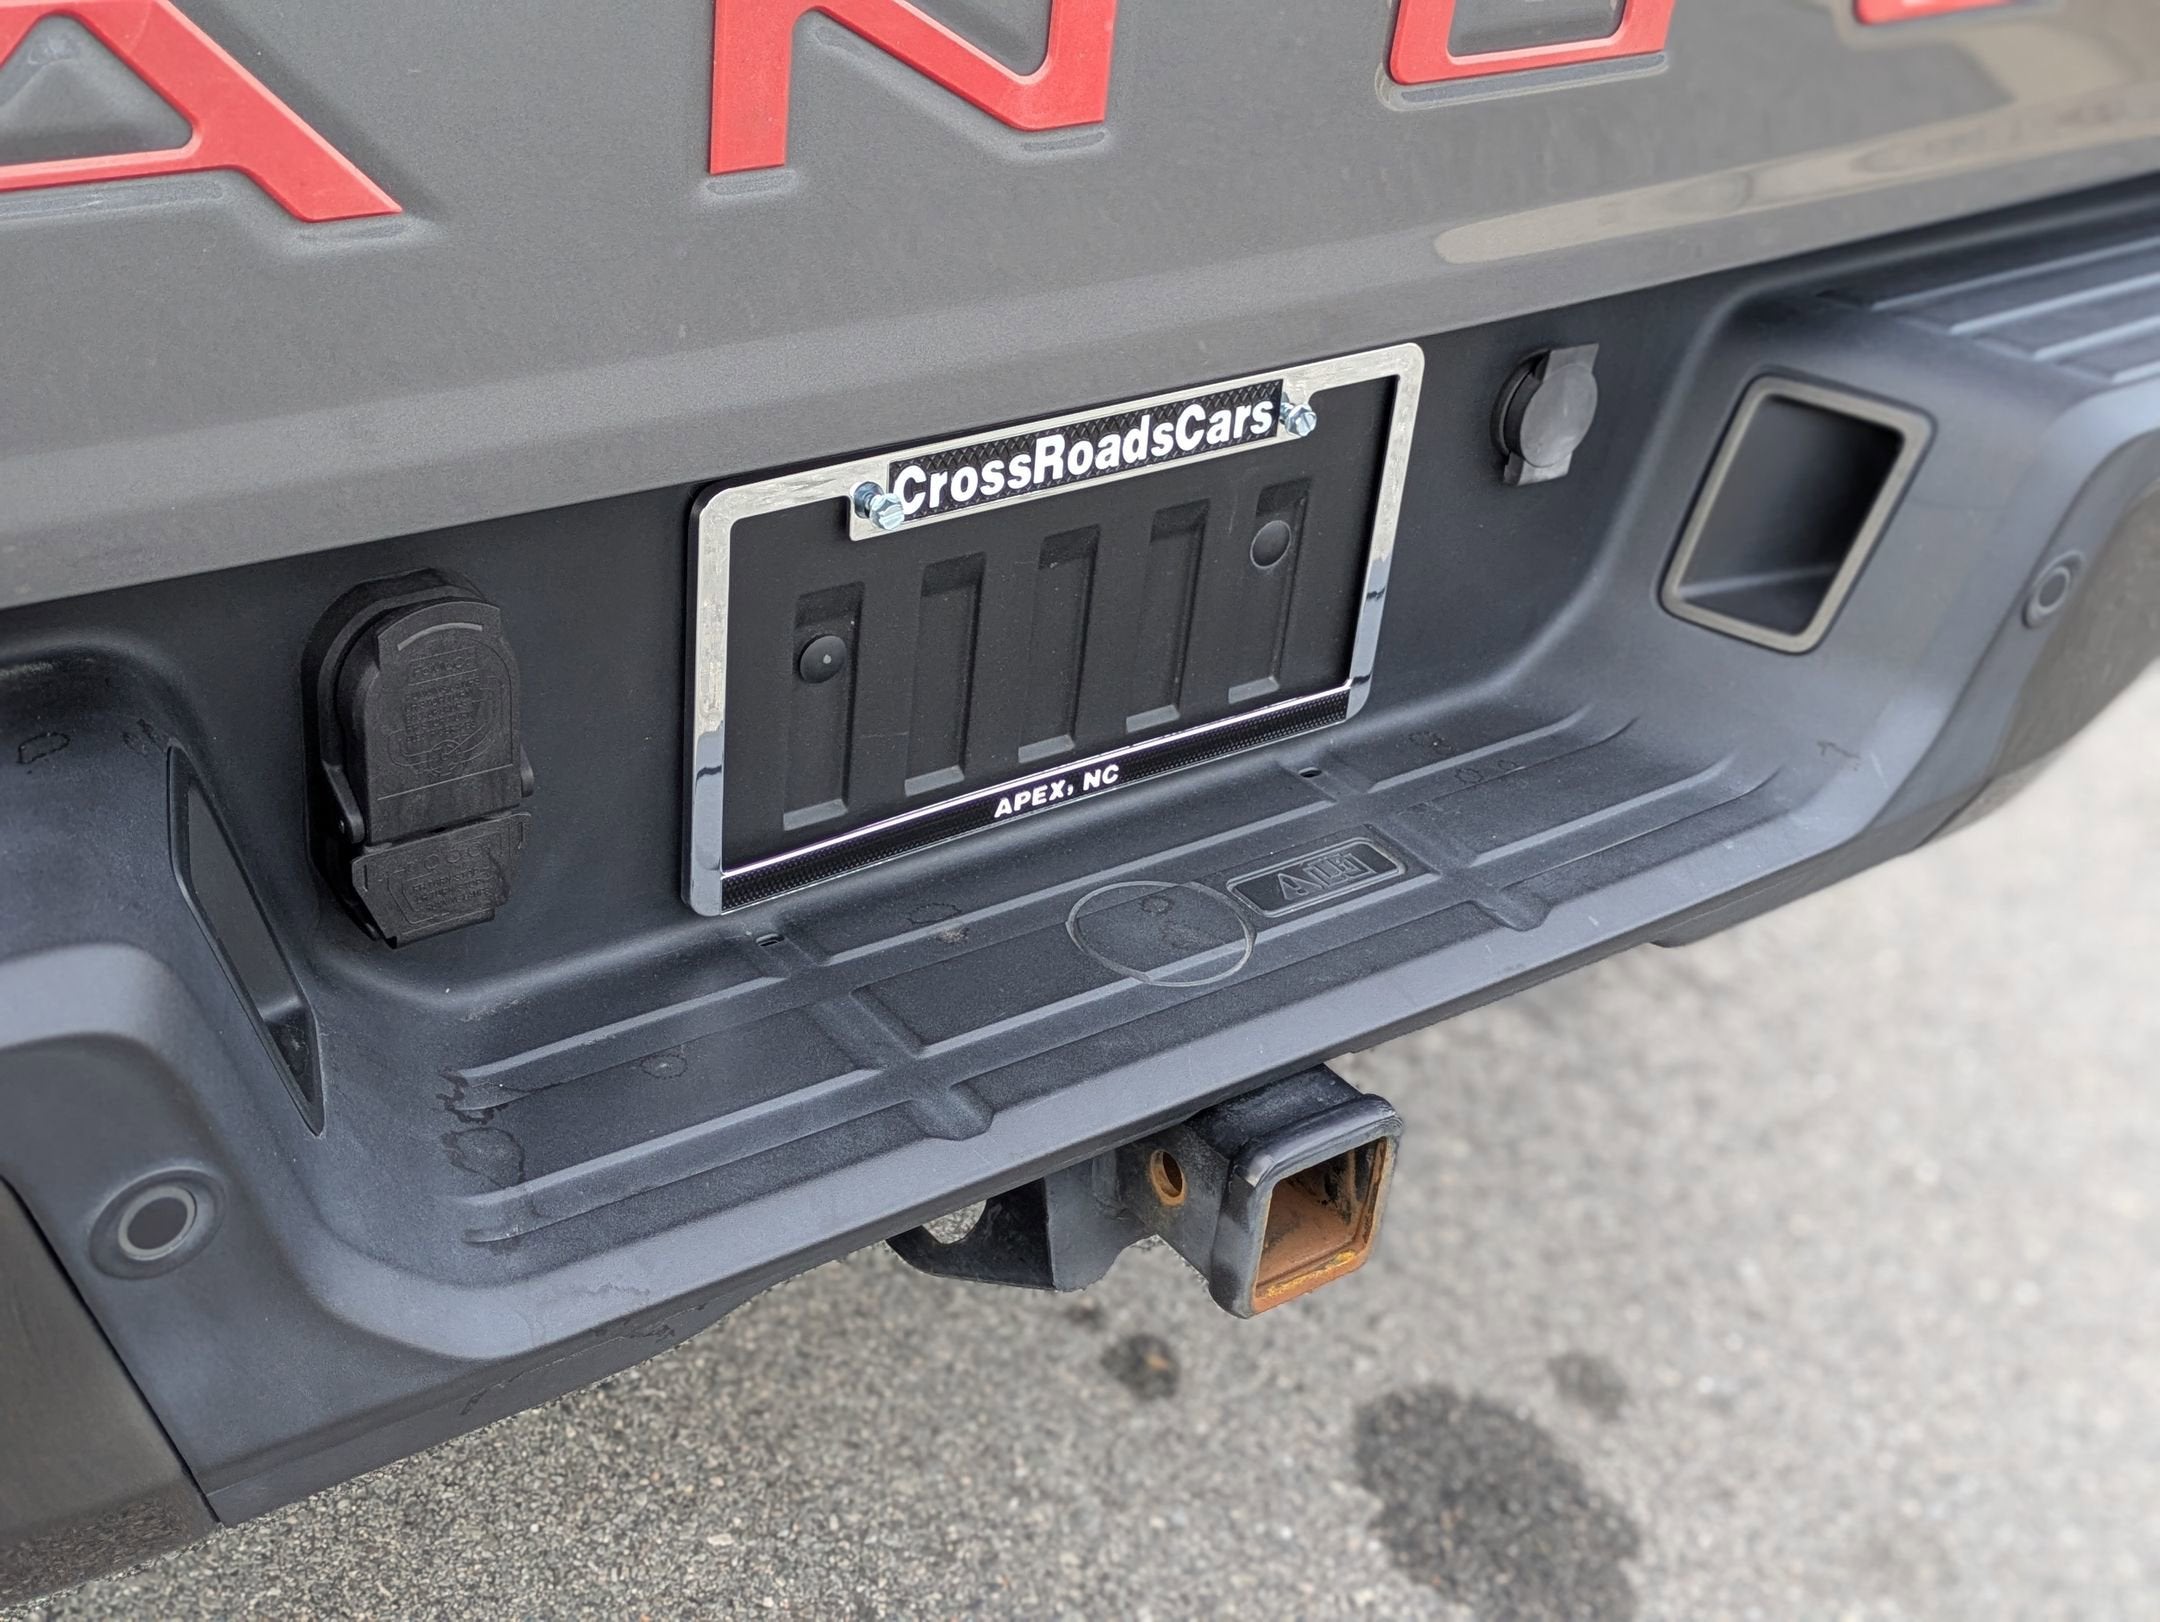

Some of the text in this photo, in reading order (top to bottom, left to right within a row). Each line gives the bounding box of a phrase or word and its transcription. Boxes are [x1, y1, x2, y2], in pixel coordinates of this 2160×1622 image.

[893, 398, 1275, 515] CrossRoadsCars
[993, 764, 1120, 818] APEX, NC
